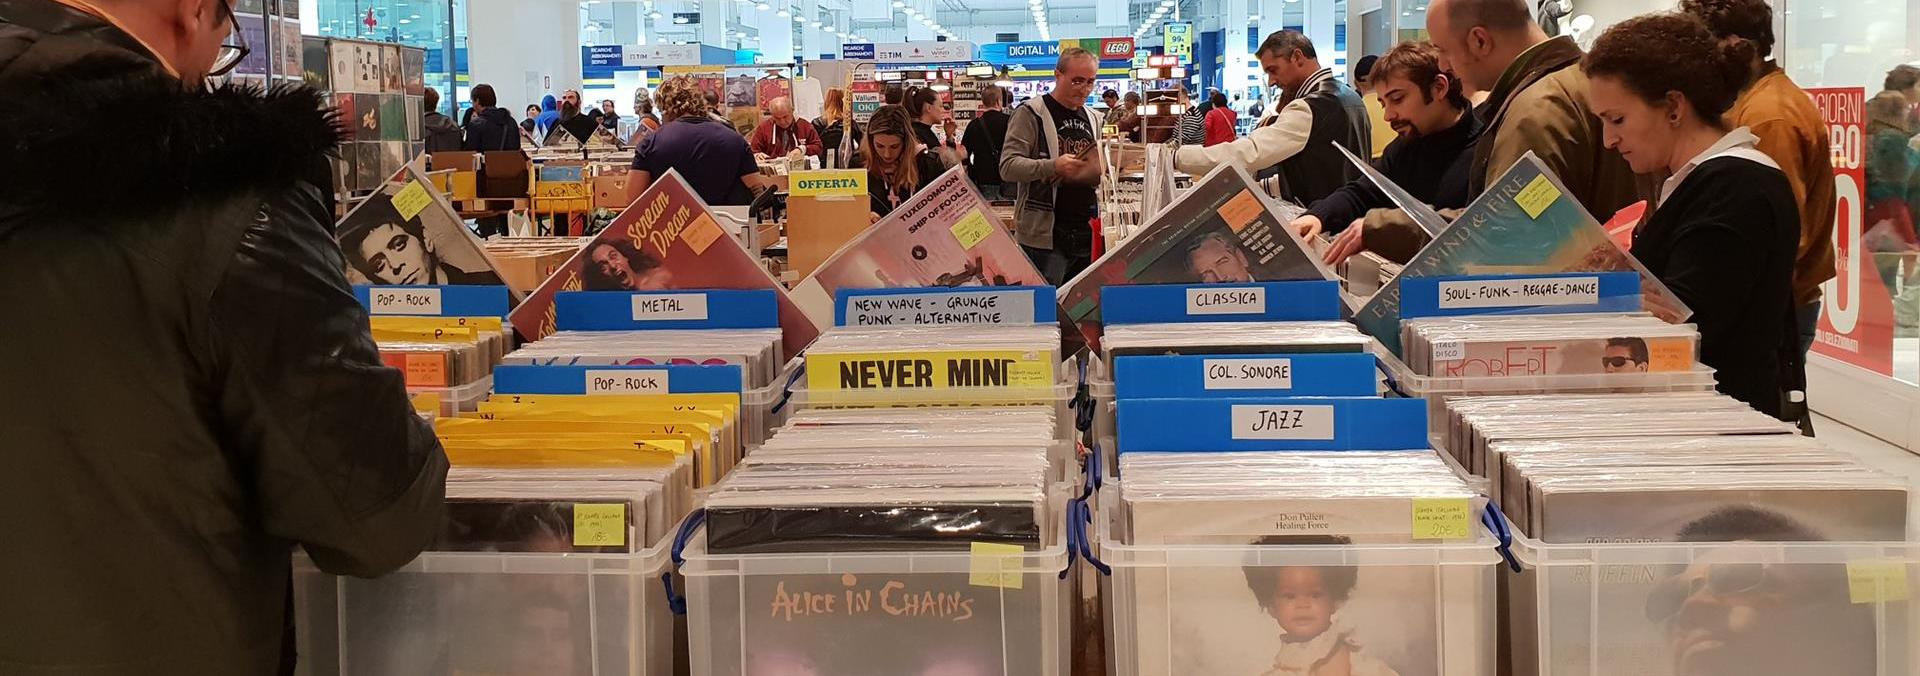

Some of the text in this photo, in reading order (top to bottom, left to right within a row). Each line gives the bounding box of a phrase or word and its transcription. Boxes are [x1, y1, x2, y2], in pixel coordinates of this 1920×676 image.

[1009, 46, 1044, 56] DIGITAL
[1106, 43, 1129, 53] LEGO
[1816, 92, 1861, 123] GIORNI
[1824, 124, 1860, 170] RO
[798, 178, 858, 189] OFFERTA
[900, 175, 959, 222] TUXEDOMOON
[908, 216, 928, 234] SHIP
[928, 207, 940, 219] OF
[939, 186, 968, 211] FOOLS
[627, 191, 669, 250] Scream
[1424, 226, 1473, 268] WIND
[1473, 212, 1488, 229] &
[1487, 174, 1528, 214] FIRE
[650, 204, 690, 258] Dream
[377, 294, 395, 306] POP
[406, 294, 431, 306] ROCK
[641, 298, 684, 313] METAL
[855, 299, 884, 312] NEW
[887, 298, 922, 311] WAVE
[947, 296, 998, 309] GRUNGE
[1195, 292, 1257, 307] CLASSICA
[858, 314, 893, 326] PUNK
[914, 312, 1001, 325] ALTERNATIVE
[1435, 350, 1458, 358] DISCO
[1446, 346, 1557, 377] ROBERT
[839, 360, 933, 389] NEVER
[1209, 363, 1289, 380] COL. SONORE
[1252, 409, 1304, 432] JAZZ
[1279, 512, 1324, 521] Don Pullen
[1275, 521, 1329, 530] Healing Force
[771, 581, 837, 622] ALICE
[879, 580, 975, 622] CHAINS
